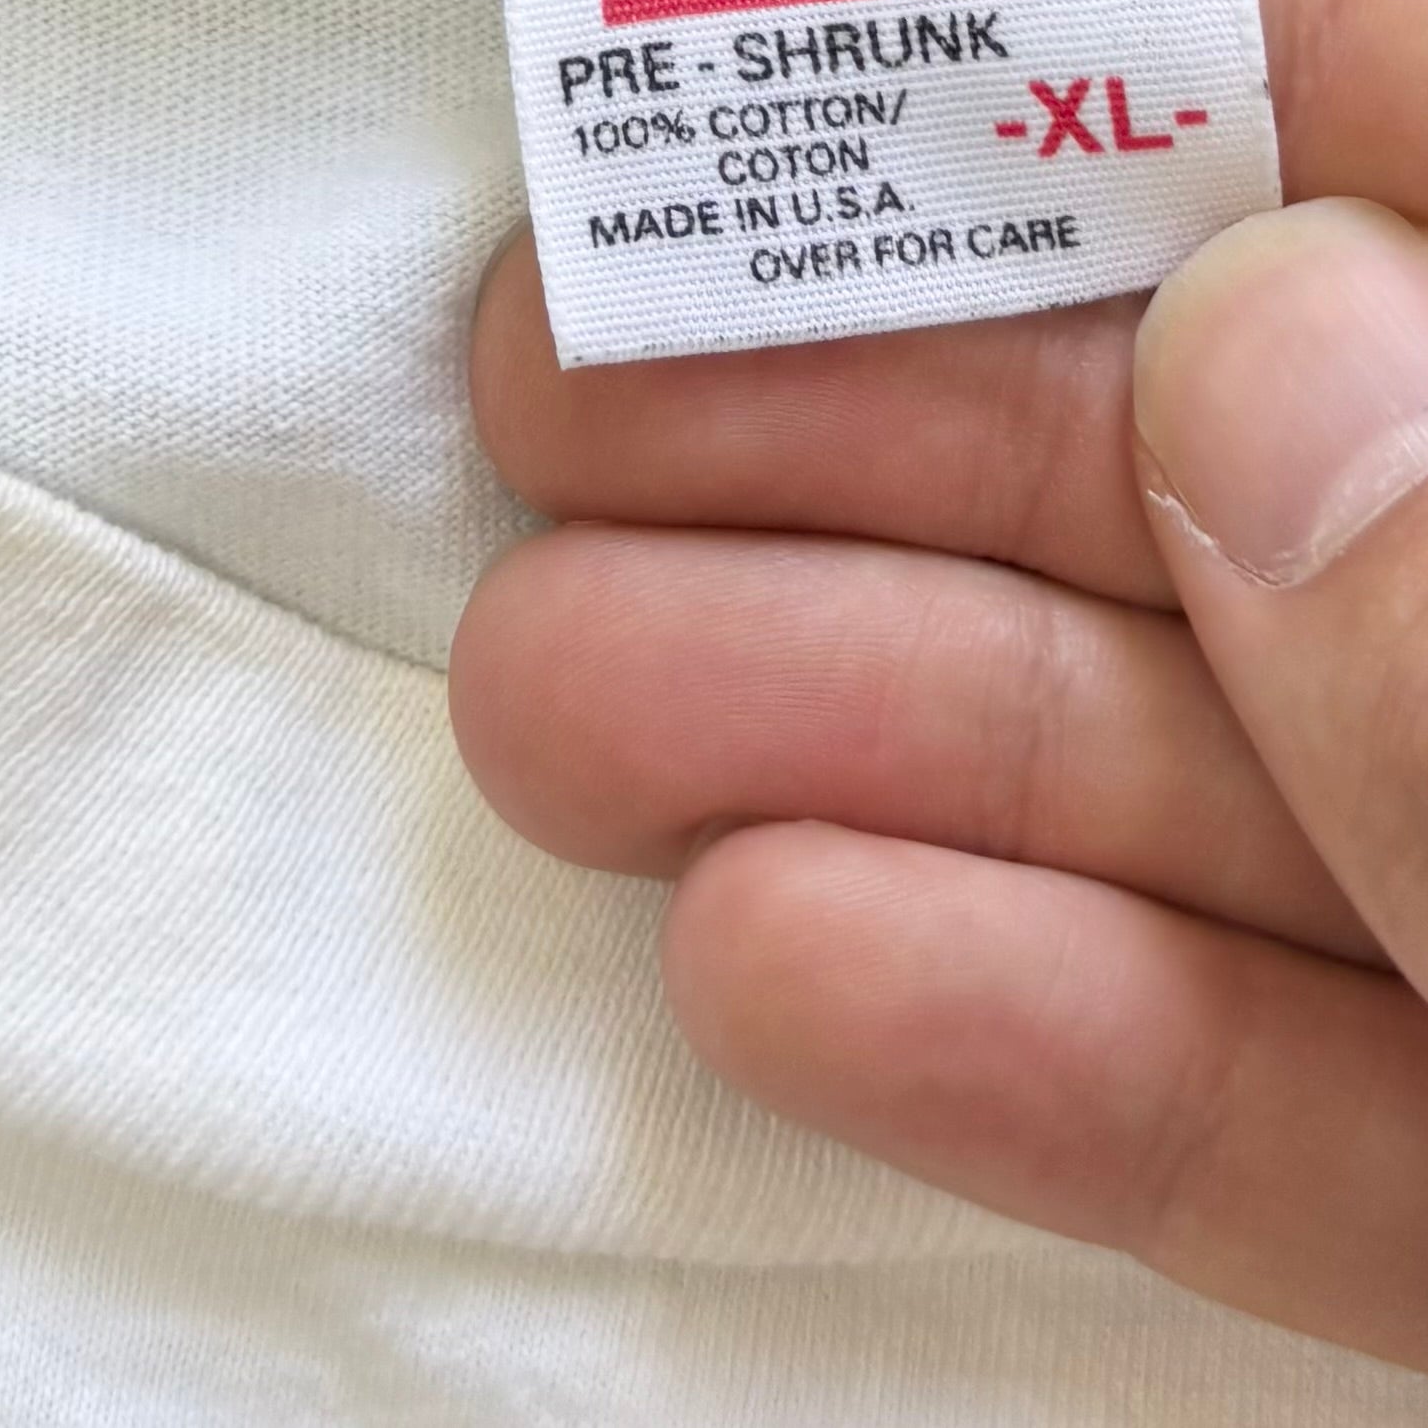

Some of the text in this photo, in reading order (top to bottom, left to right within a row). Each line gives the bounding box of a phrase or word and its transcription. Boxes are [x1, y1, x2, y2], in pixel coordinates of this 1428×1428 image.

[576, 89, 908, 156] 100% COTTON/
[718, 138, 871, 187] COTON
[589, 182, 916, 249] MADE IN U.S.A.
[750, 216, 1083, 284] OVER FOR CARE
